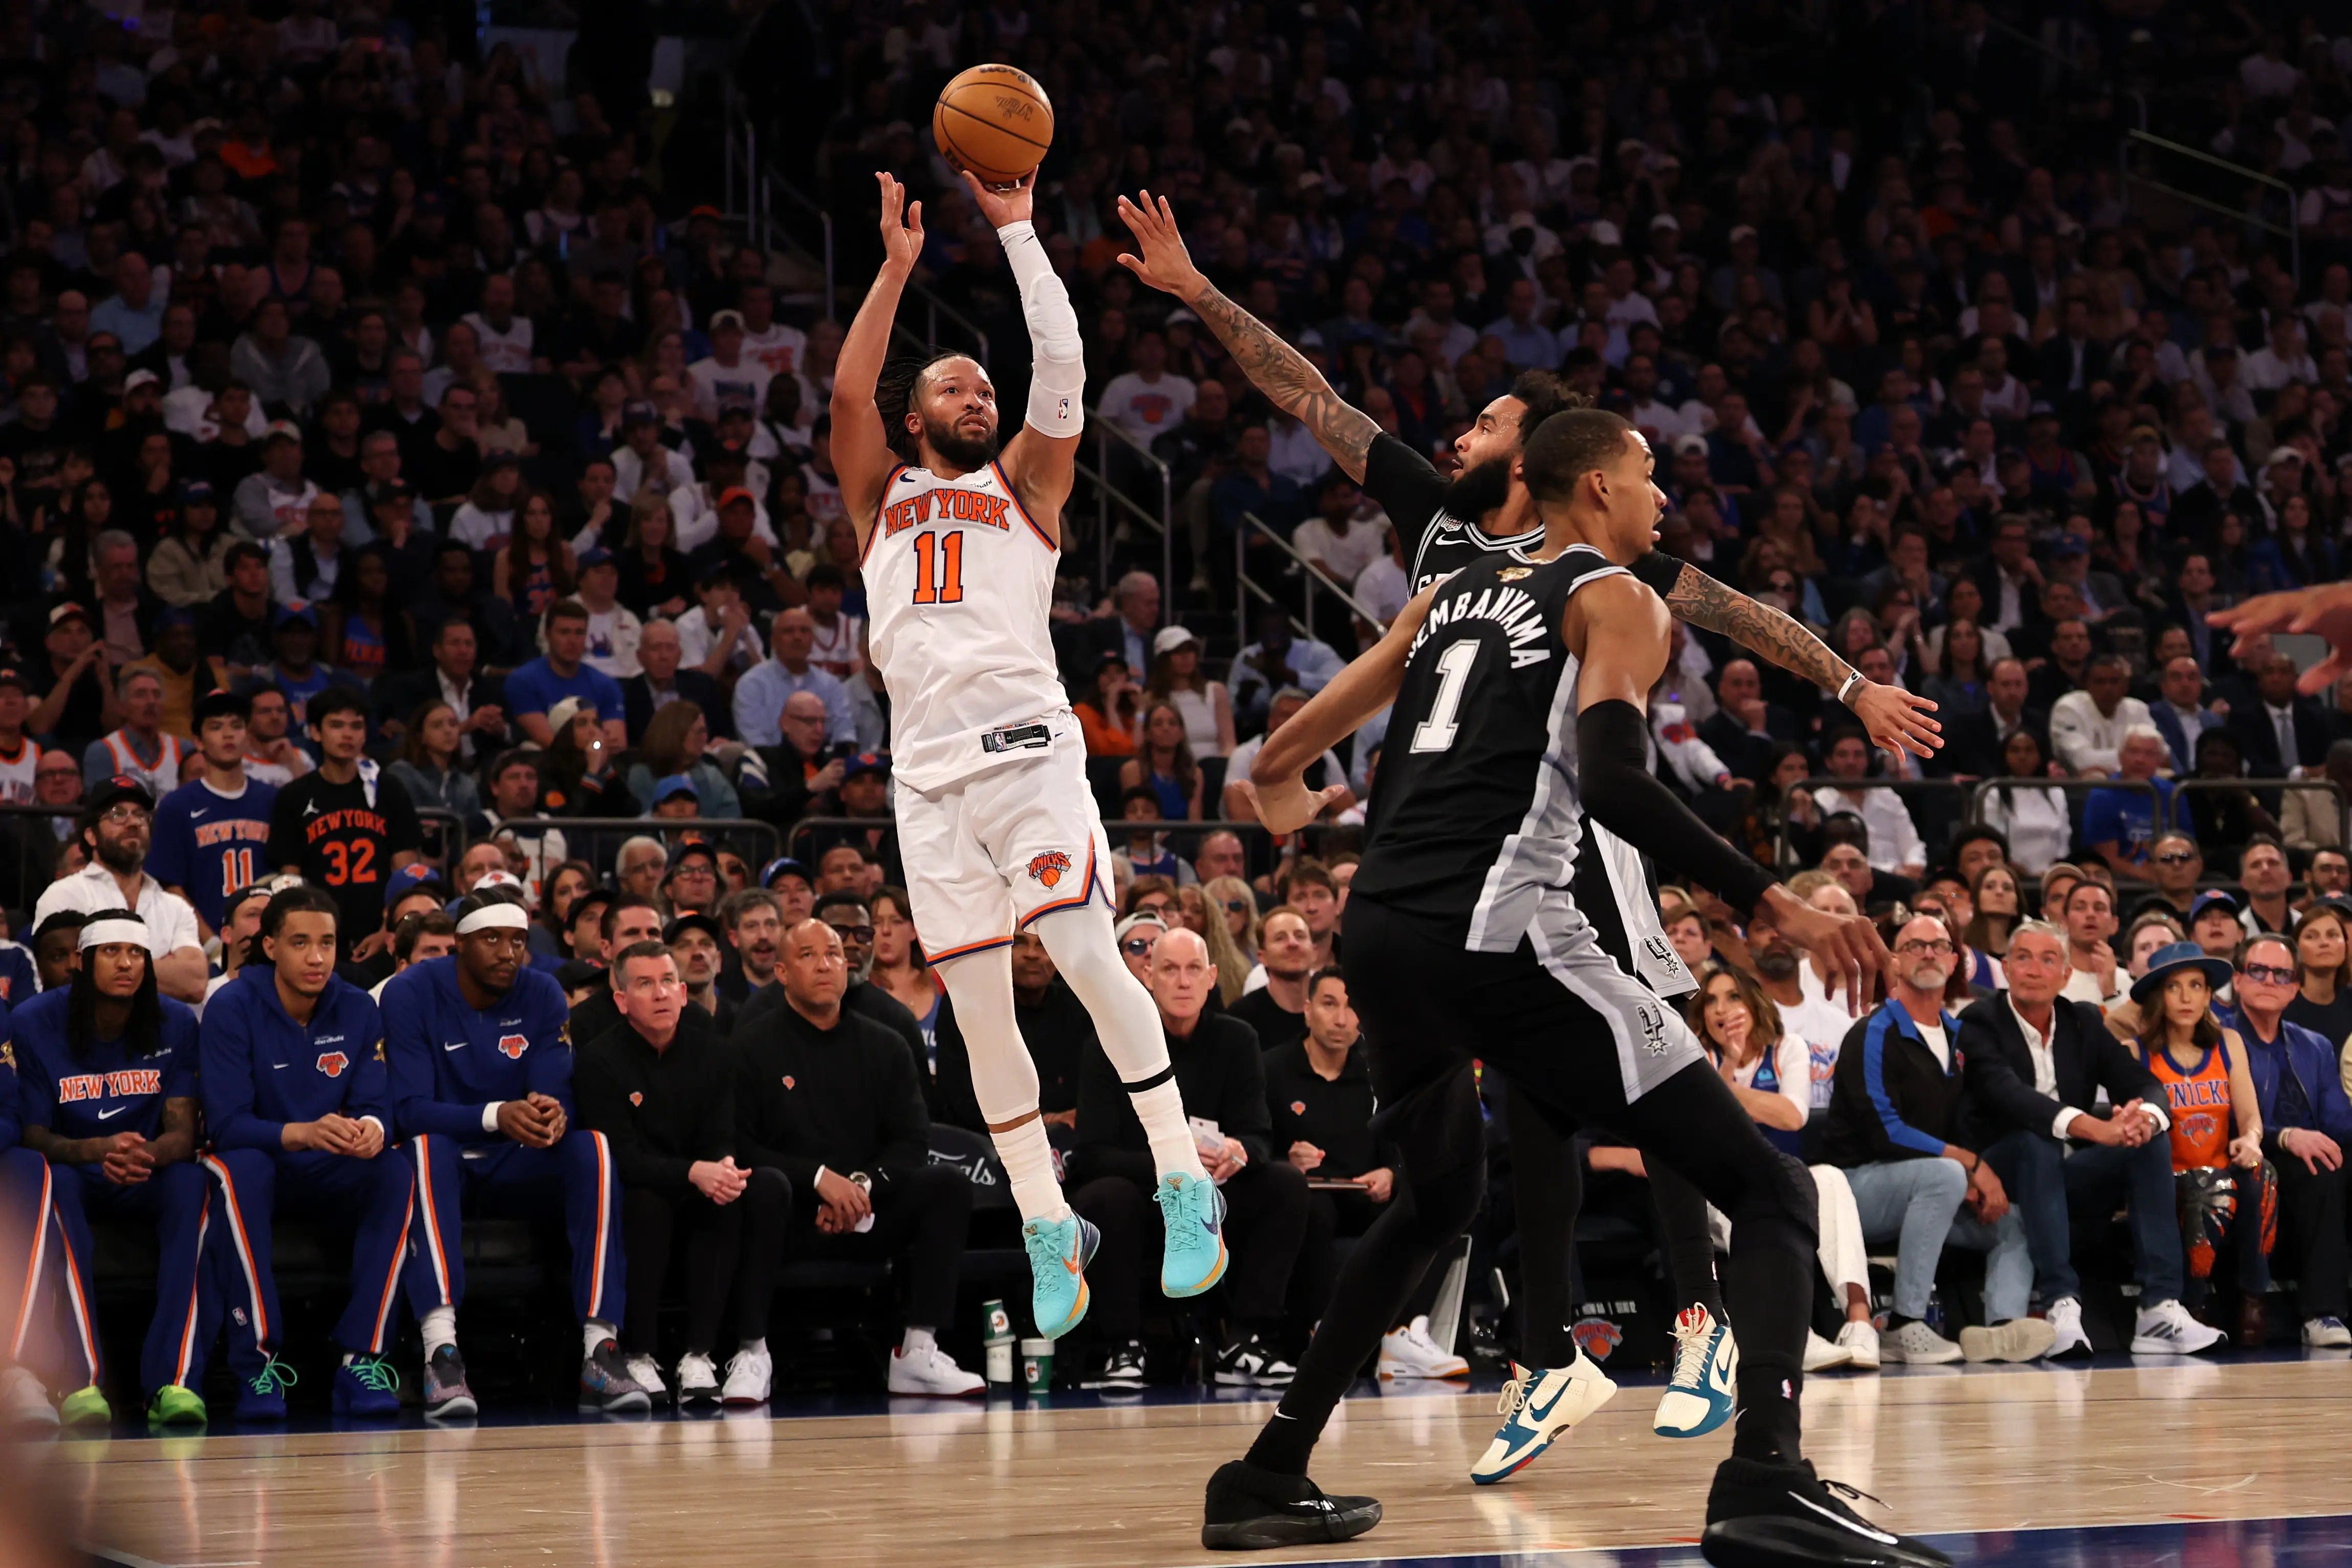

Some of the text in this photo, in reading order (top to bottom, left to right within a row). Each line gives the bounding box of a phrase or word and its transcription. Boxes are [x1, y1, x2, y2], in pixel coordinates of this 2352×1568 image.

[884, 488, 1010, 540] NEW YORK
[912, 530, 963, 605] 11
[1409, 638, 1481, 754] 1
[195, 818, 271, 848] NEW YORK
[305, 808, 388, 844] NEW YORK
[221, 847, 254, 898] 11
[321, 837, 377, 886] 32
[1029, 852, 1072, 877] KNICKS
[59, 1069, 162, 1104] NEW YORK
[2163, 1080, 2230, 1109] NICK
